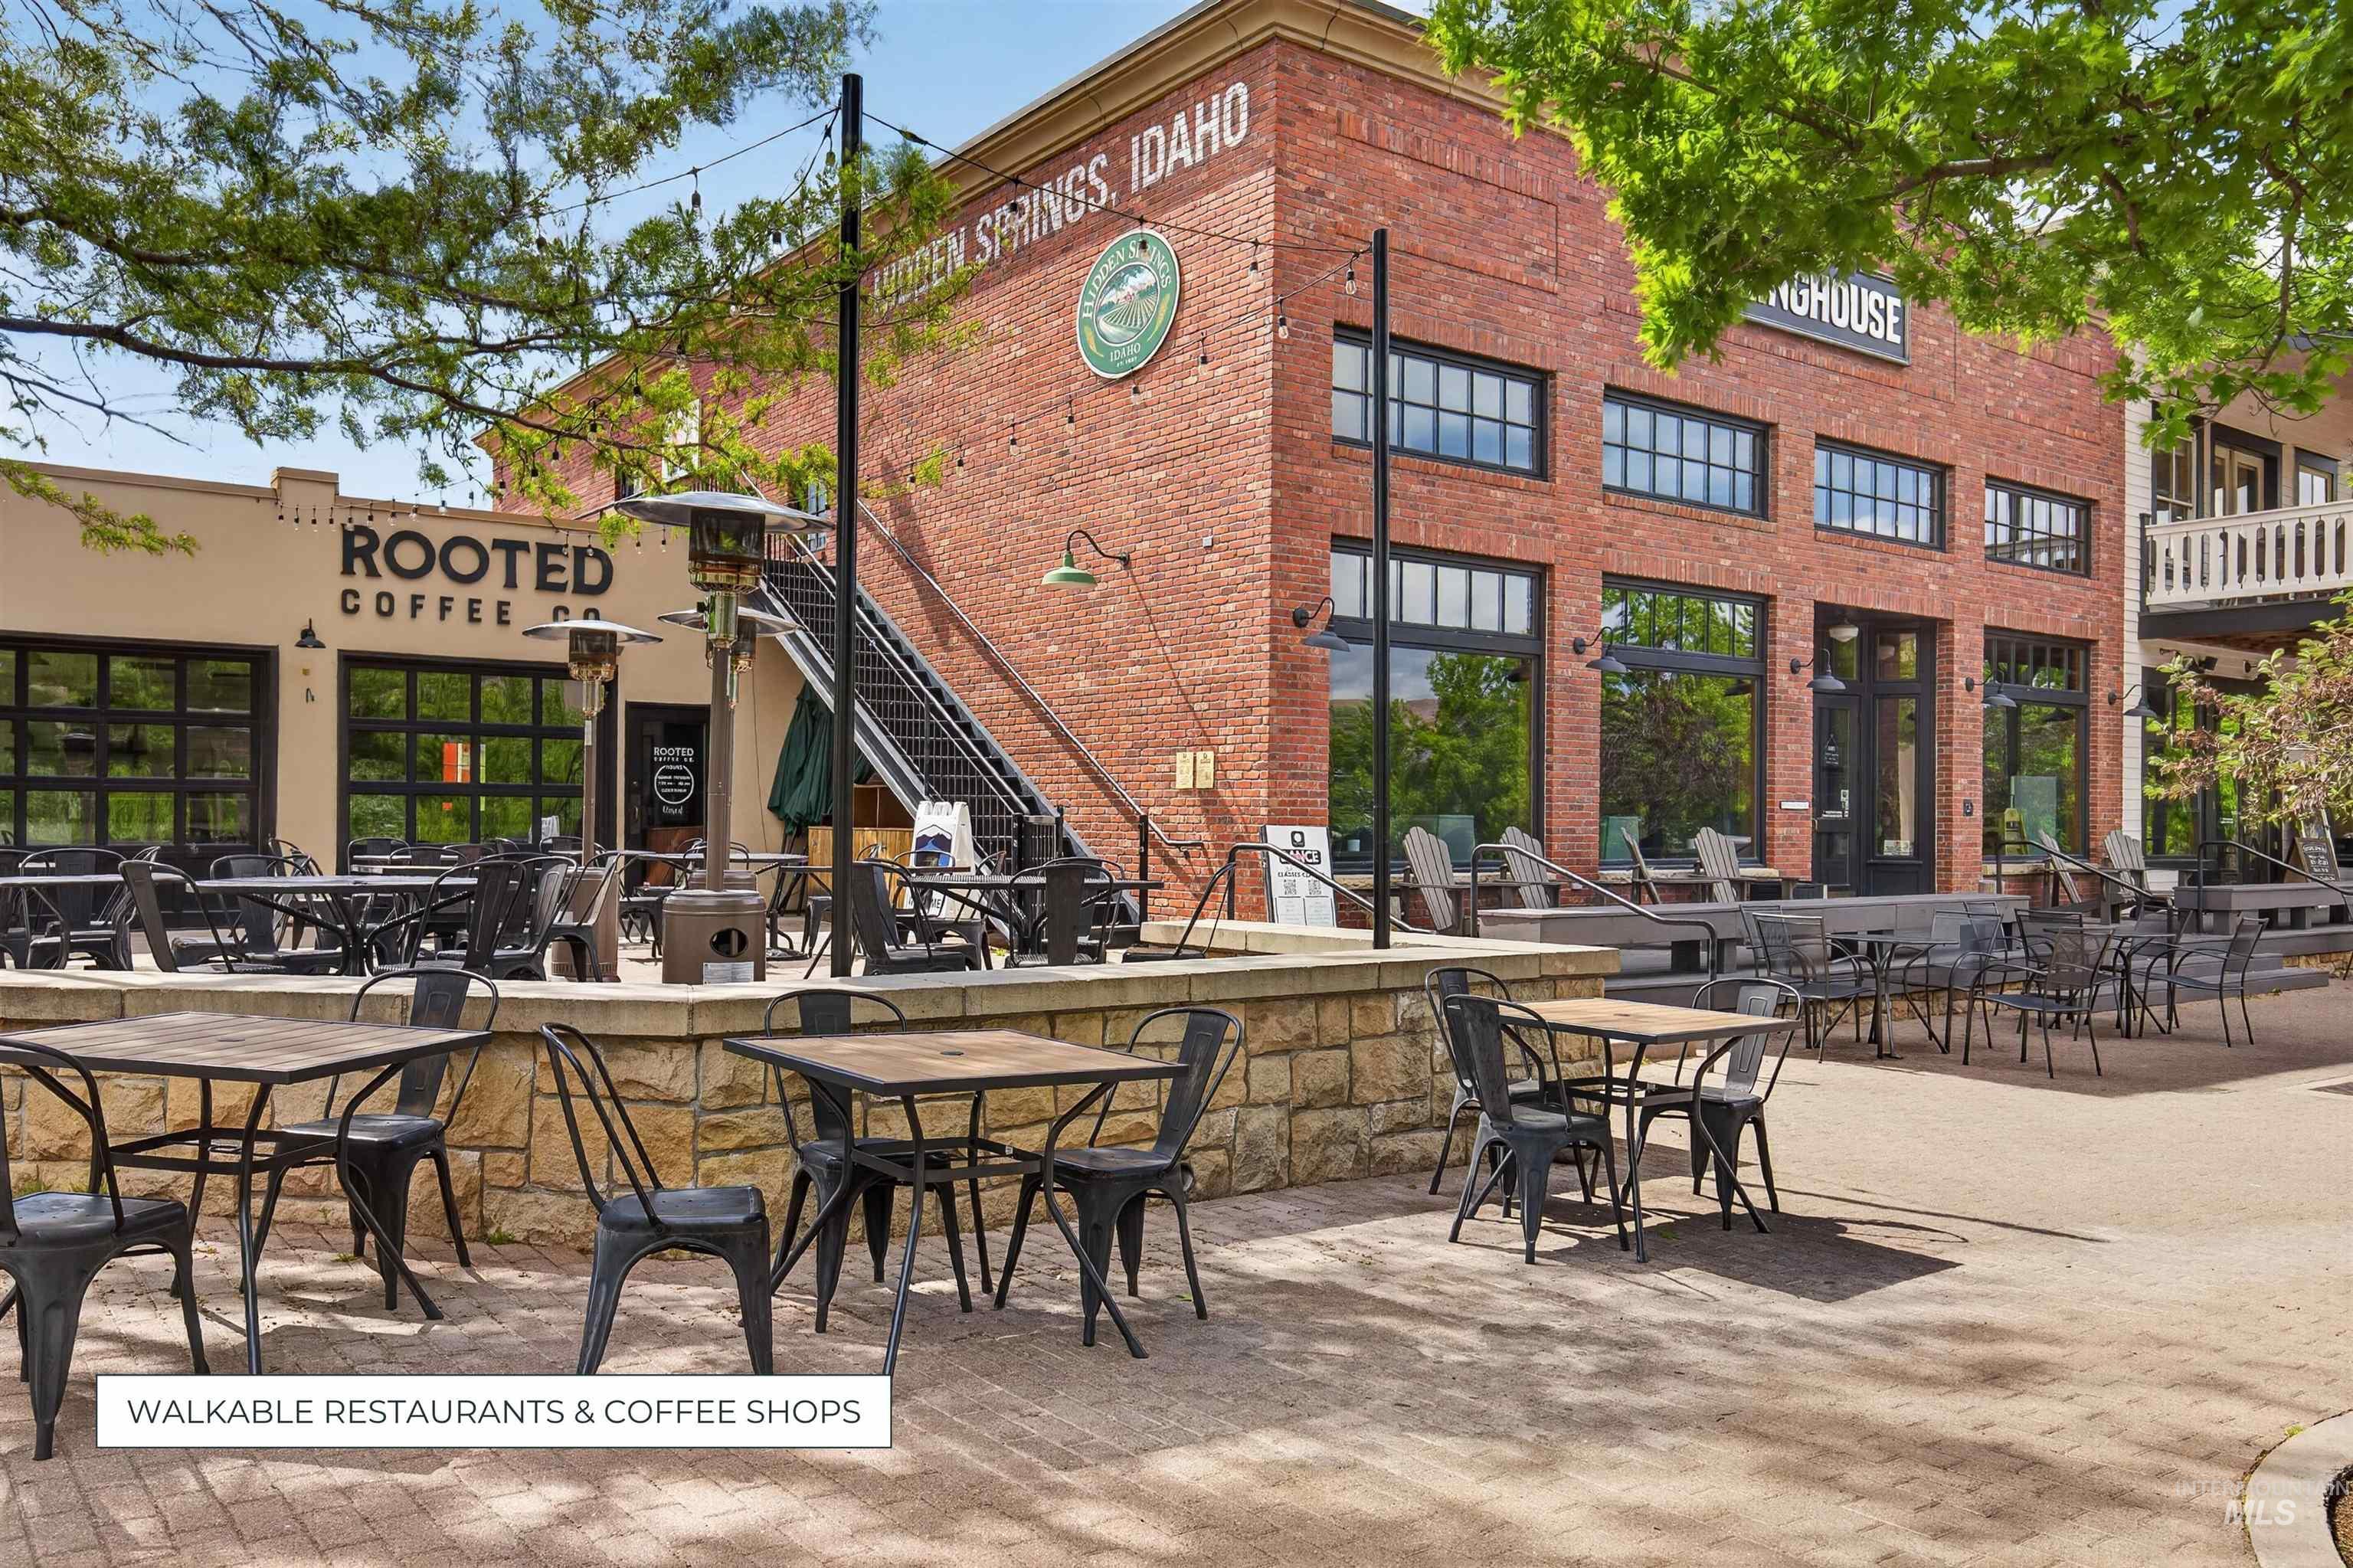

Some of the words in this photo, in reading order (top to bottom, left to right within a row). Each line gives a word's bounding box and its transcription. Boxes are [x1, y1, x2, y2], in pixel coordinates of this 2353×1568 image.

[1131, 82, 1248, 194] IDAHO
[1082, 247, 1125, 319] HIDDEN
[1111, 342, 1141, 362] IDAHO
[340, 523, 614, 595] ROOTED
[341, 588, 511, 624] COFFEE
[654, 747, 694, 756] ROOTED
